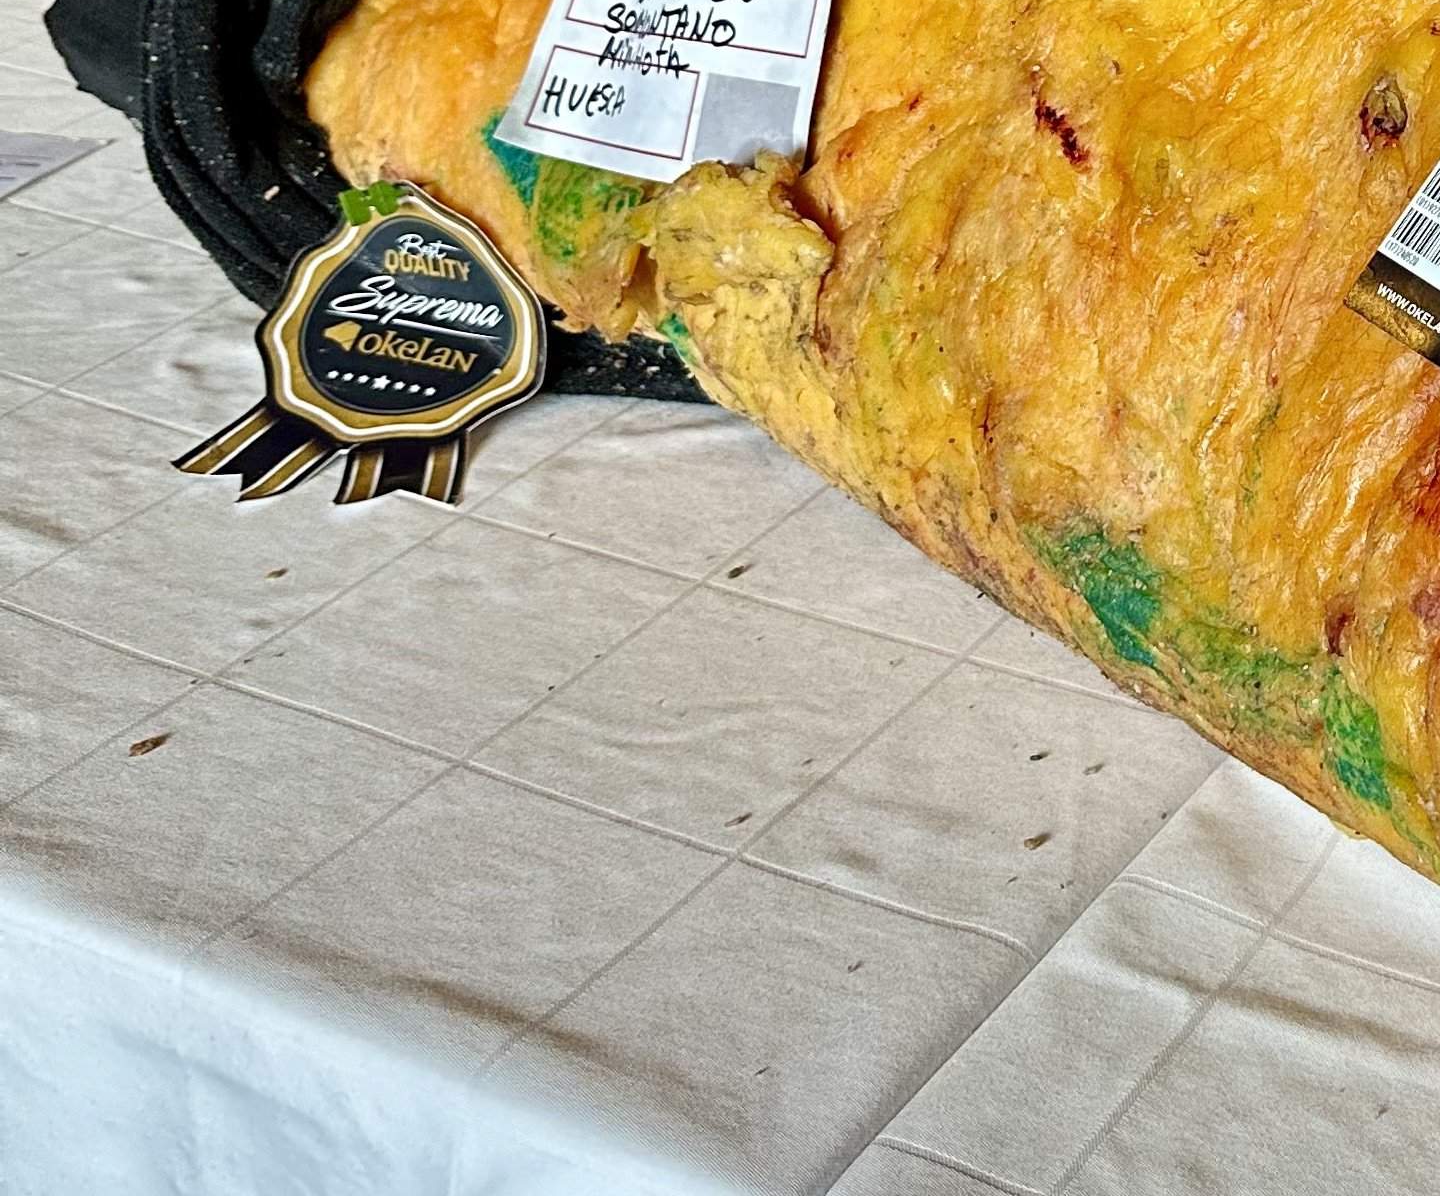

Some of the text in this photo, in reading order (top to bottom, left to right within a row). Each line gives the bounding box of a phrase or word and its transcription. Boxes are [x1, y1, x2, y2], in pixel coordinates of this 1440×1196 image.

[395, 233, 463, 260] Best
[384, 248, 472, 282] QUALITY
[329, 275, 504, 329] Suprema
